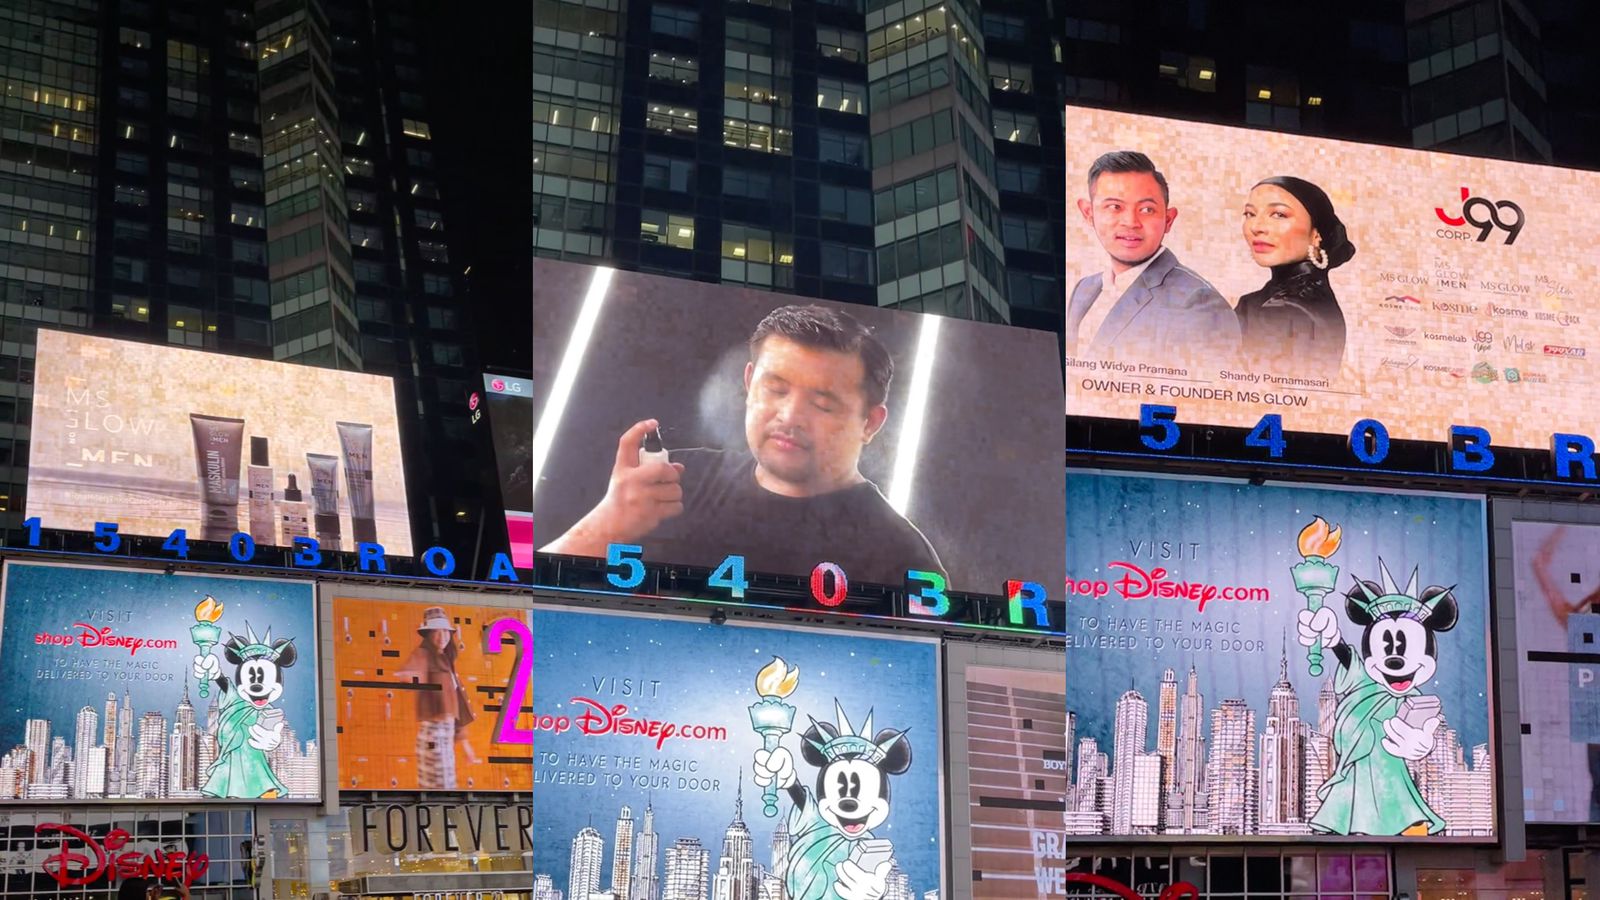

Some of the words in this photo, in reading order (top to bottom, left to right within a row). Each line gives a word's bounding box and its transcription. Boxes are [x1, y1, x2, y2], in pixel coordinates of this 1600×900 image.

[1380, 272, 1396, 282] MS
[1397, 273, 1429, 285] GLOW
[1441, 279, 1467, 289] MEN
[1480, 281, 1496, 290] MS
[1497, 282, 1530, 294] GLOW
[1099, 359, 1136, 373] Widya
[1139, 363, 1188, 376] Pramana
[505, 382, 521, 392] LG
[1219, 370, 1260, 384] Shandy
[1263, 374, 1329, 388] Purnamasari
[1081, 378, 1141, 395] OWNER
[1146, 384, 1156, 395] &
[1160, 385, 1233, 402] FOUNDER
[1237, 391, 1260, 403] MS
[1263, 393, 1308, 407] GLOW
[471, 409, 481, 425] LG
[206, 450, 220, 494] MASKULIN
[1129, 540, 1201, 560] VISIT
[87, 609, 133, 623] VISIT
[1079, 616, 1099, 631] TO
[1107, 617, 1149, 632] HAVE
[1155, 619, 1183, 633] THE
[1191, 622, 1242, 635] MAGIC
[1145, 636, 1165, 651] TO
[1172, 638, 1213, 651] YOUR
[1220, 639, 1265, 653] DOOR
[54, 658, 67, 668] TO
[73, 659, 100, 668] HAVE
[103, 659, 121, 669] THE
[126, 661, 159, 670] MAGIC
[36, 669, 92, 680] DELIVERED
[97, 670, 109, 681] TO
[113, 671, 141, 681] YOUR
[145, 672, 175, 682] DOOR
[592, 675, 662, 698] VISIT
[540, 752, 560, 766] TO
[567, 753, 608, 769] HAVE
[614, 755, 641, 769] THE
[649, 758, 698, 773] MAGIC
[603, 773, 623, 787] TO
[630, 775, 670, 789] YOUR
[677, 778, 721, 792] DOOR
[362, 804, 533, 852] FOREVER
